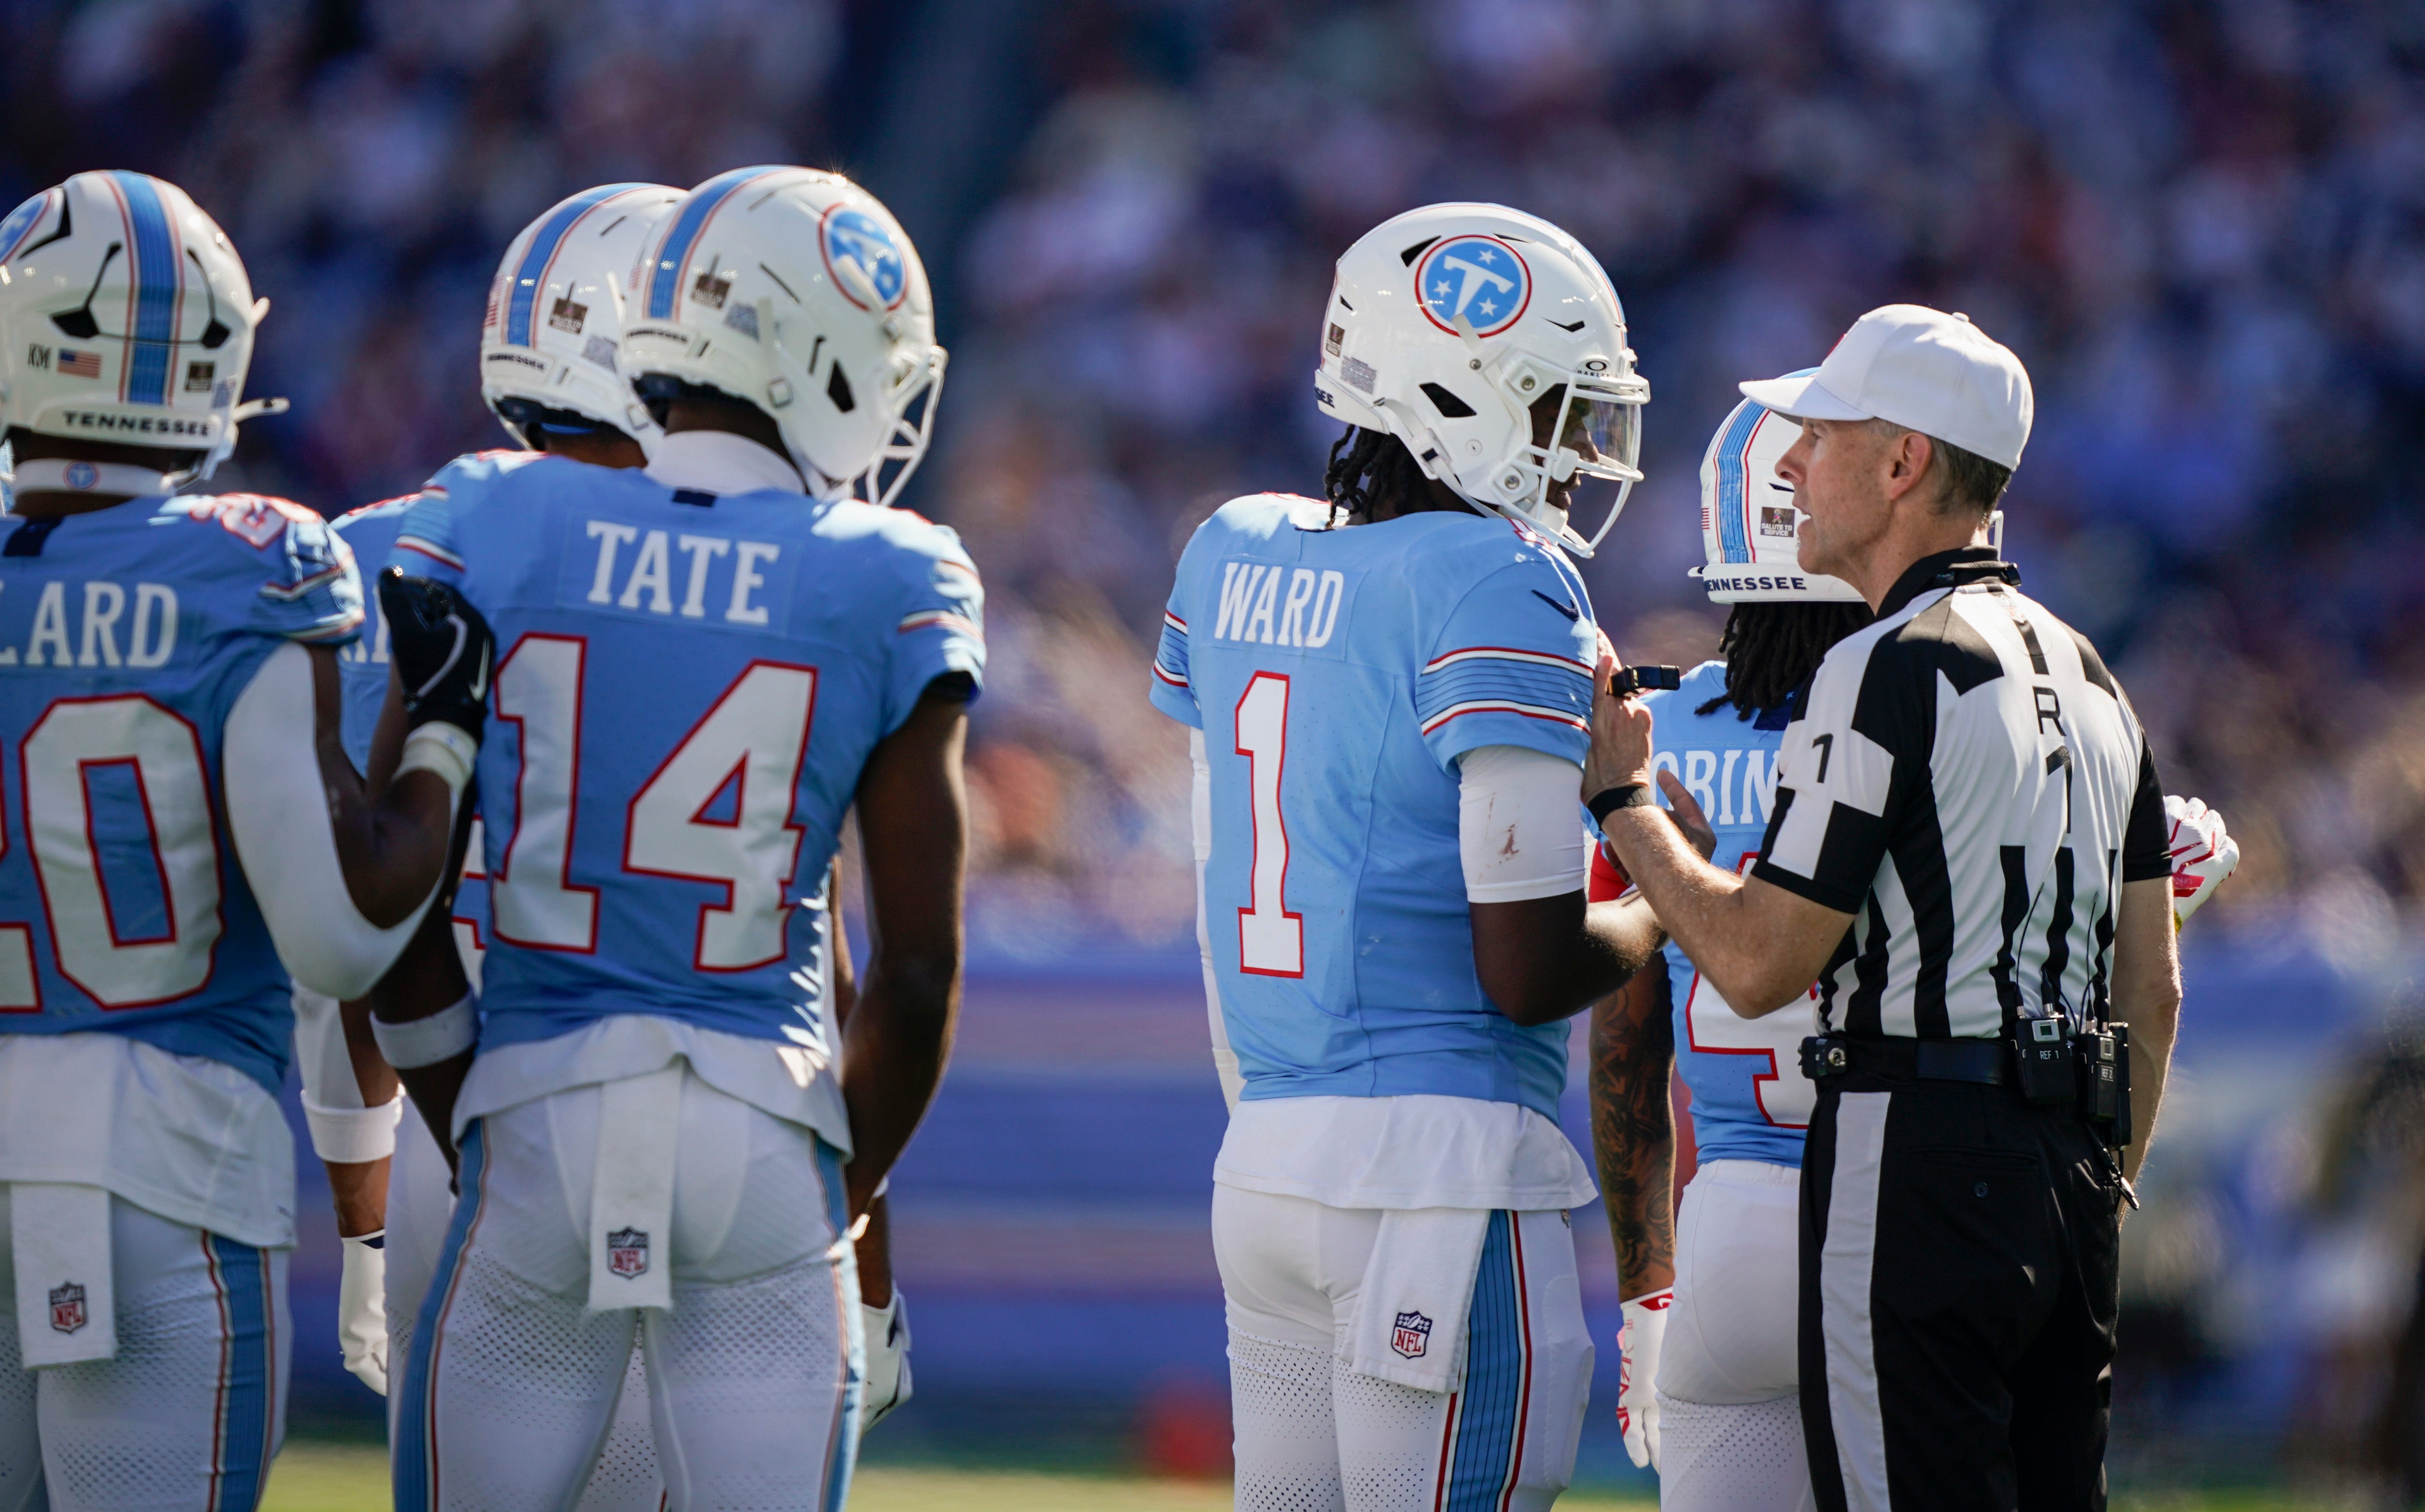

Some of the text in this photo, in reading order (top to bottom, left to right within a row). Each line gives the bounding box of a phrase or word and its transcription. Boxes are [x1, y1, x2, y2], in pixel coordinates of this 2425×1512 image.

[63, 410, 209, 437] TENNESSEE
[586, 520, 781, 626] TATE
[1214, 562, 1344, 647] WARD
[1703, 577, 1807, 592] ENNESSEE
[0, 581, 179, 668] ARD
[2032, 686, 2067, 737] R
[1812, 733, 1833, 784] 1
[491, 631, 819, 973] 14
[1234, 670, 1304, 979] 1
[0, 691, 226, 1013] 0
[2039, 1050, 2060, 1060] REF 1
[1395, 1329, 1421, 1352] NFL
